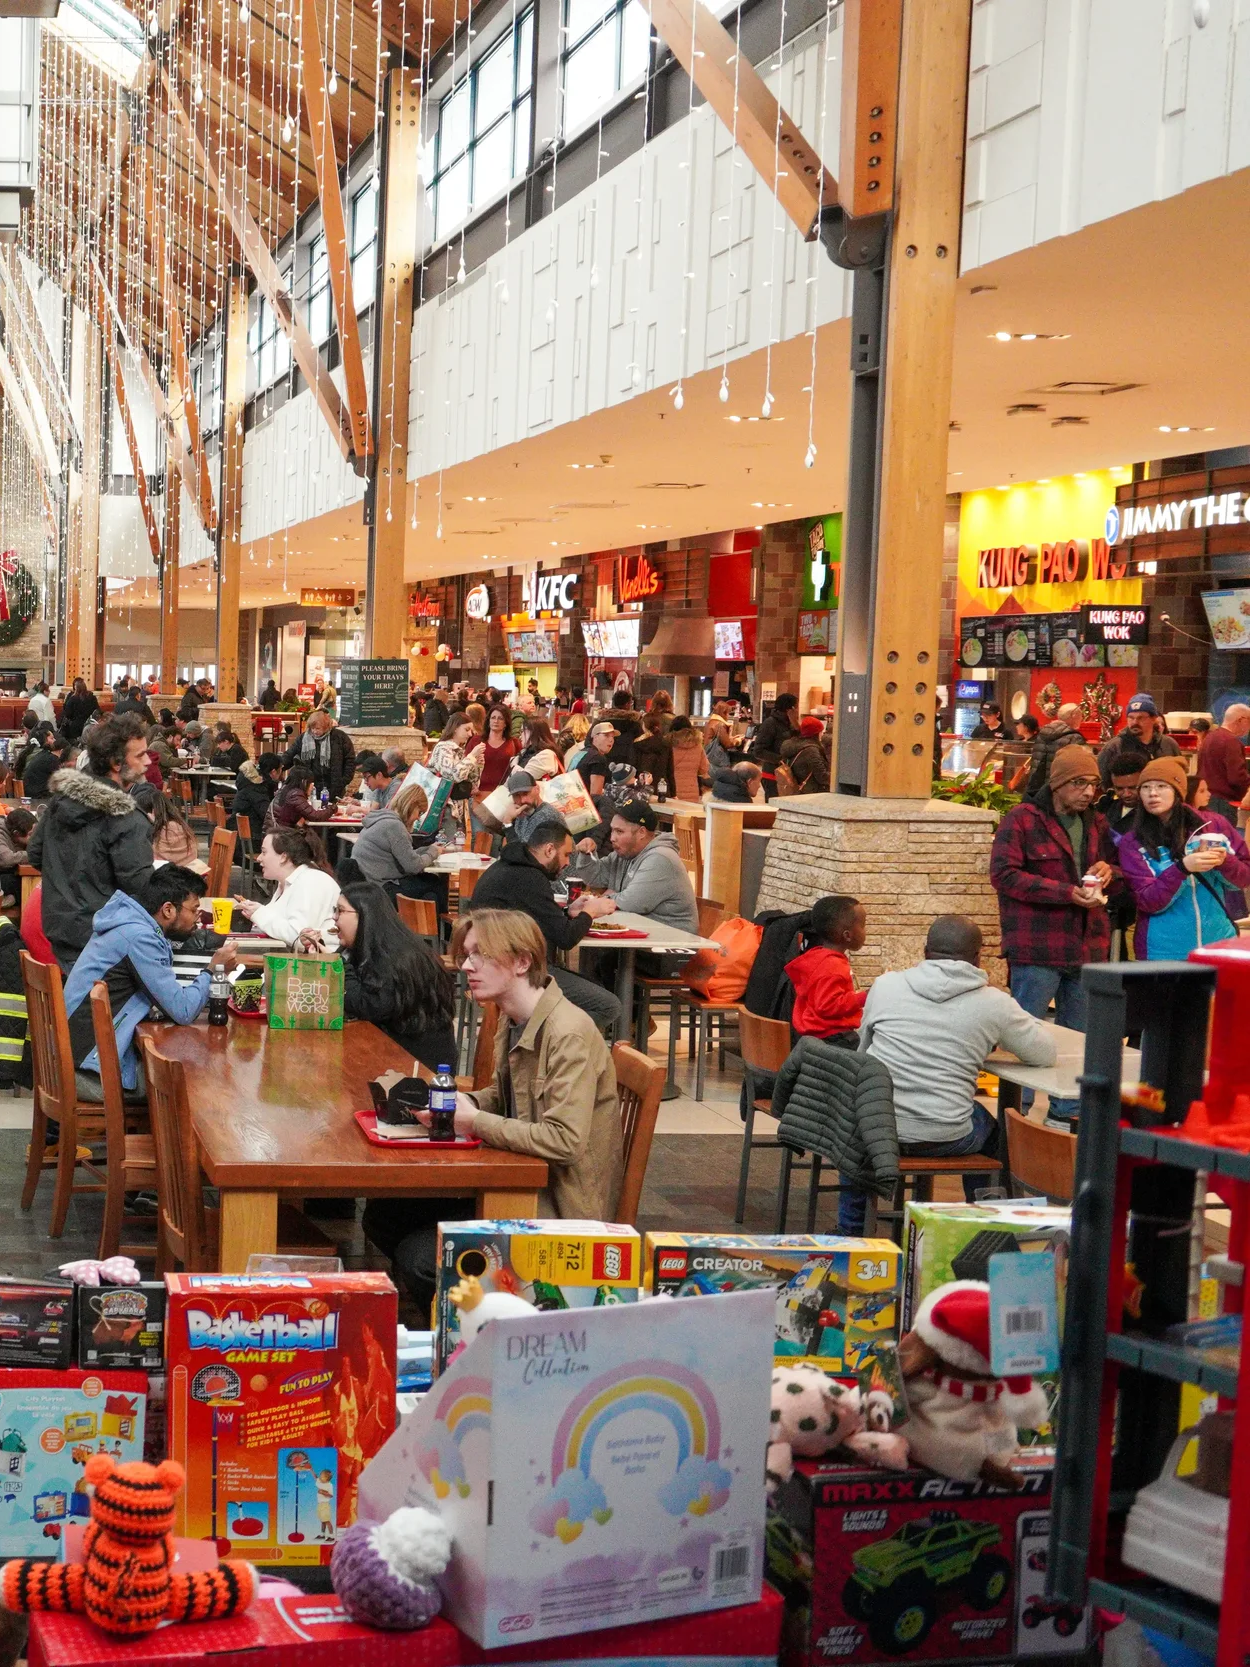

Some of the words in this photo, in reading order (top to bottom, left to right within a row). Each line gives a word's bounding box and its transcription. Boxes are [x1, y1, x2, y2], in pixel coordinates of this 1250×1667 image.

[1122, 500, 1188, 539] JIMMY
[1190, 492, 1240, 528] THE
[977, 544, 1030, 588] KUNG
[1040, 538, 1079, 583] PAO
[536, 574, 578, 610] KFC
[1089, 610, 1120, 624] KUNG
[1122, 610, 1145, 624] PAO
[1103, 625, 1130, 640] WOK
[287, 977, 329, 996] Bath
[287, 1002, 329, 1013] Works
[538, 1249, 546, 1265] 588
[566, 1242, 581, 1270] 7-12
[603, 1244, 621, 1279] LEGO
[660, 1258, 686, 1269] LEGO
[692, 1258, 763, 1271] CREATOR
[187, 1310, 340, 1353] Basketball
[506, 1328, 586, 1360] DREAM
[226, 1352, 268, 1363] GAME
[271, 1352, 297, 1363] SET
[279, 1383, 296, 1395] FUN
[298, 1379, 310, 1389] TO
[311, 1371, 334, 1385] PLAY
[246, 1411, 258, 1419] FOR
[260, 1404, 290, 1416] OUTDOOR
[297, 1396, 321, 1408] INDOOR
[247, 1417, 270, 1426] SAFETY
[271, 1413, 288, 1421] PLAY
[289, 1409, 304, 1417] BALL
[246, 1427, 265, 1435] QUICK
[273, 1420, 290, 1429] EASY
[291, 1417, 300, 1425] TO
[301, 1410, 331, 1422] ASSEMBLE
[246, 1440, 258, 1449] FOR
[259, 1438, 273, 1446] KIDS
